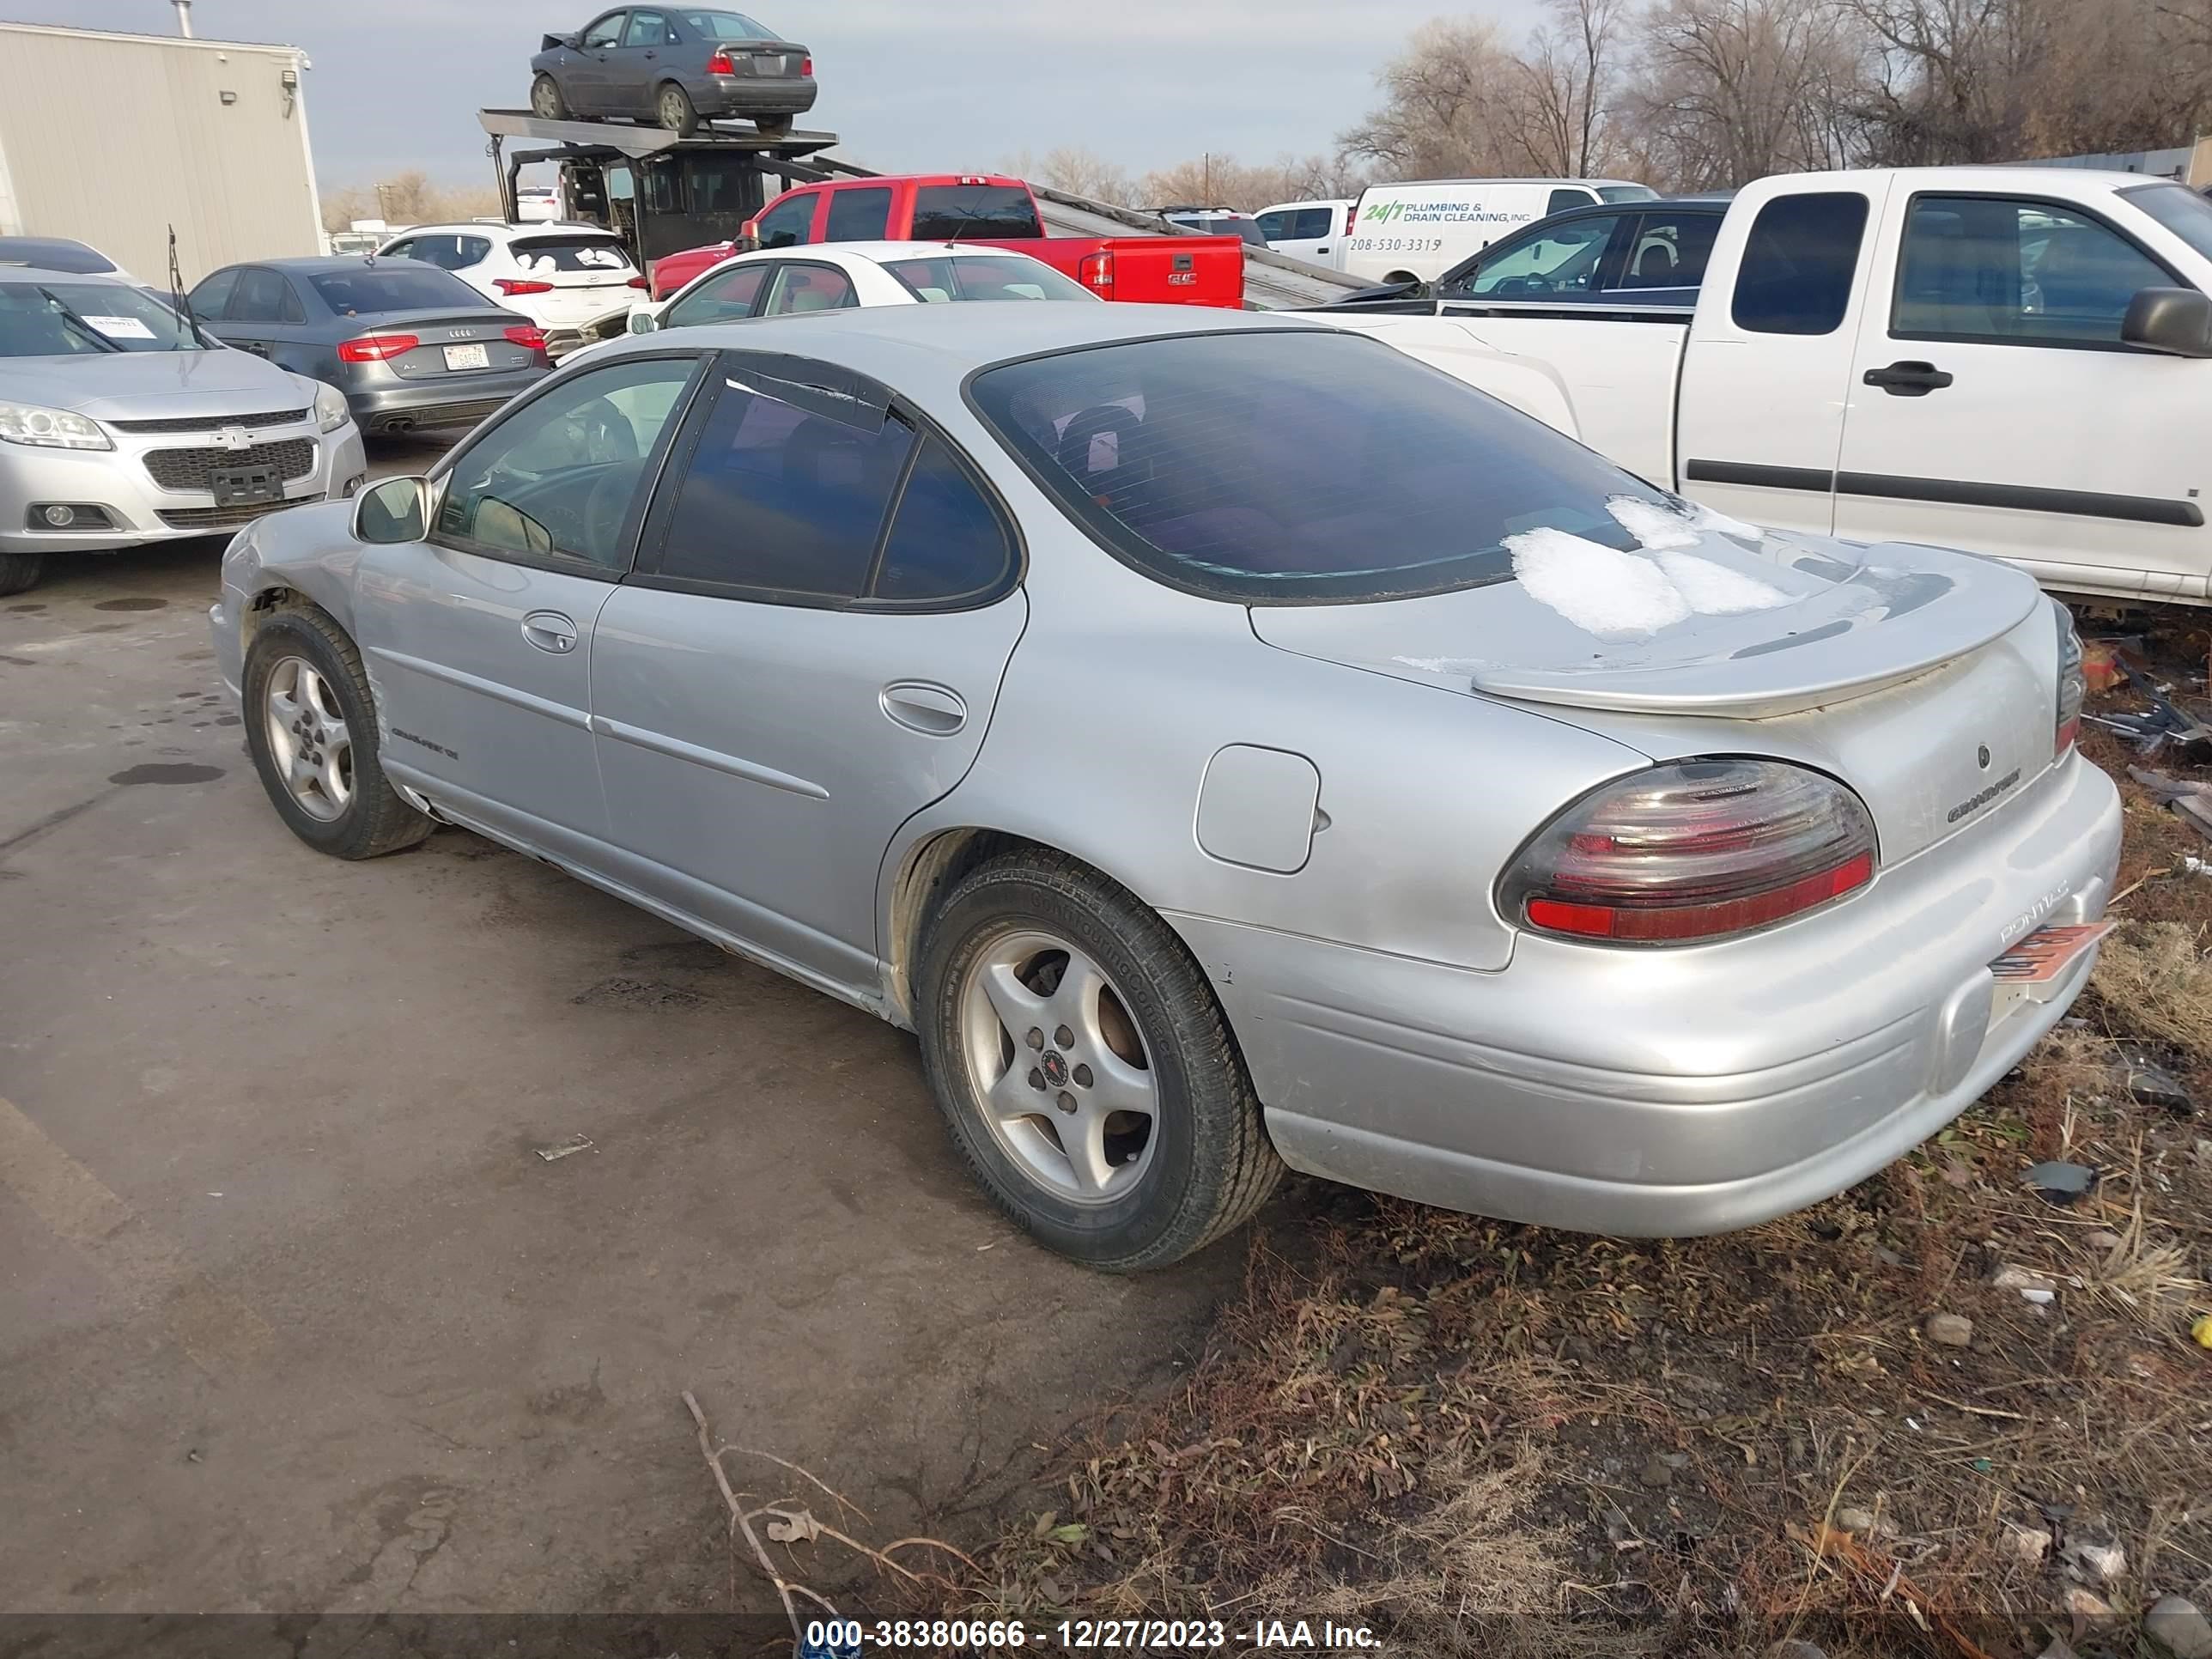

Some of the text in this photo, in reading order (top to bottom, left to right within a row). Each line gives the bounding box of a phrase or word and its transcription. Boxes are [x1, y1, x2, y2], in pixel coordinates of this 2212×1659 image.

[1363, 199, 1482, 225] 24/7 PLUMBING &
[1403, 212, 1442, 223] DRAIN
[1444, 212, 1510, 223] CLEANING,
[1350, 238, 1443, 252] 208-530-3319
[2000, 878, 2070, 945] PONTIAC
